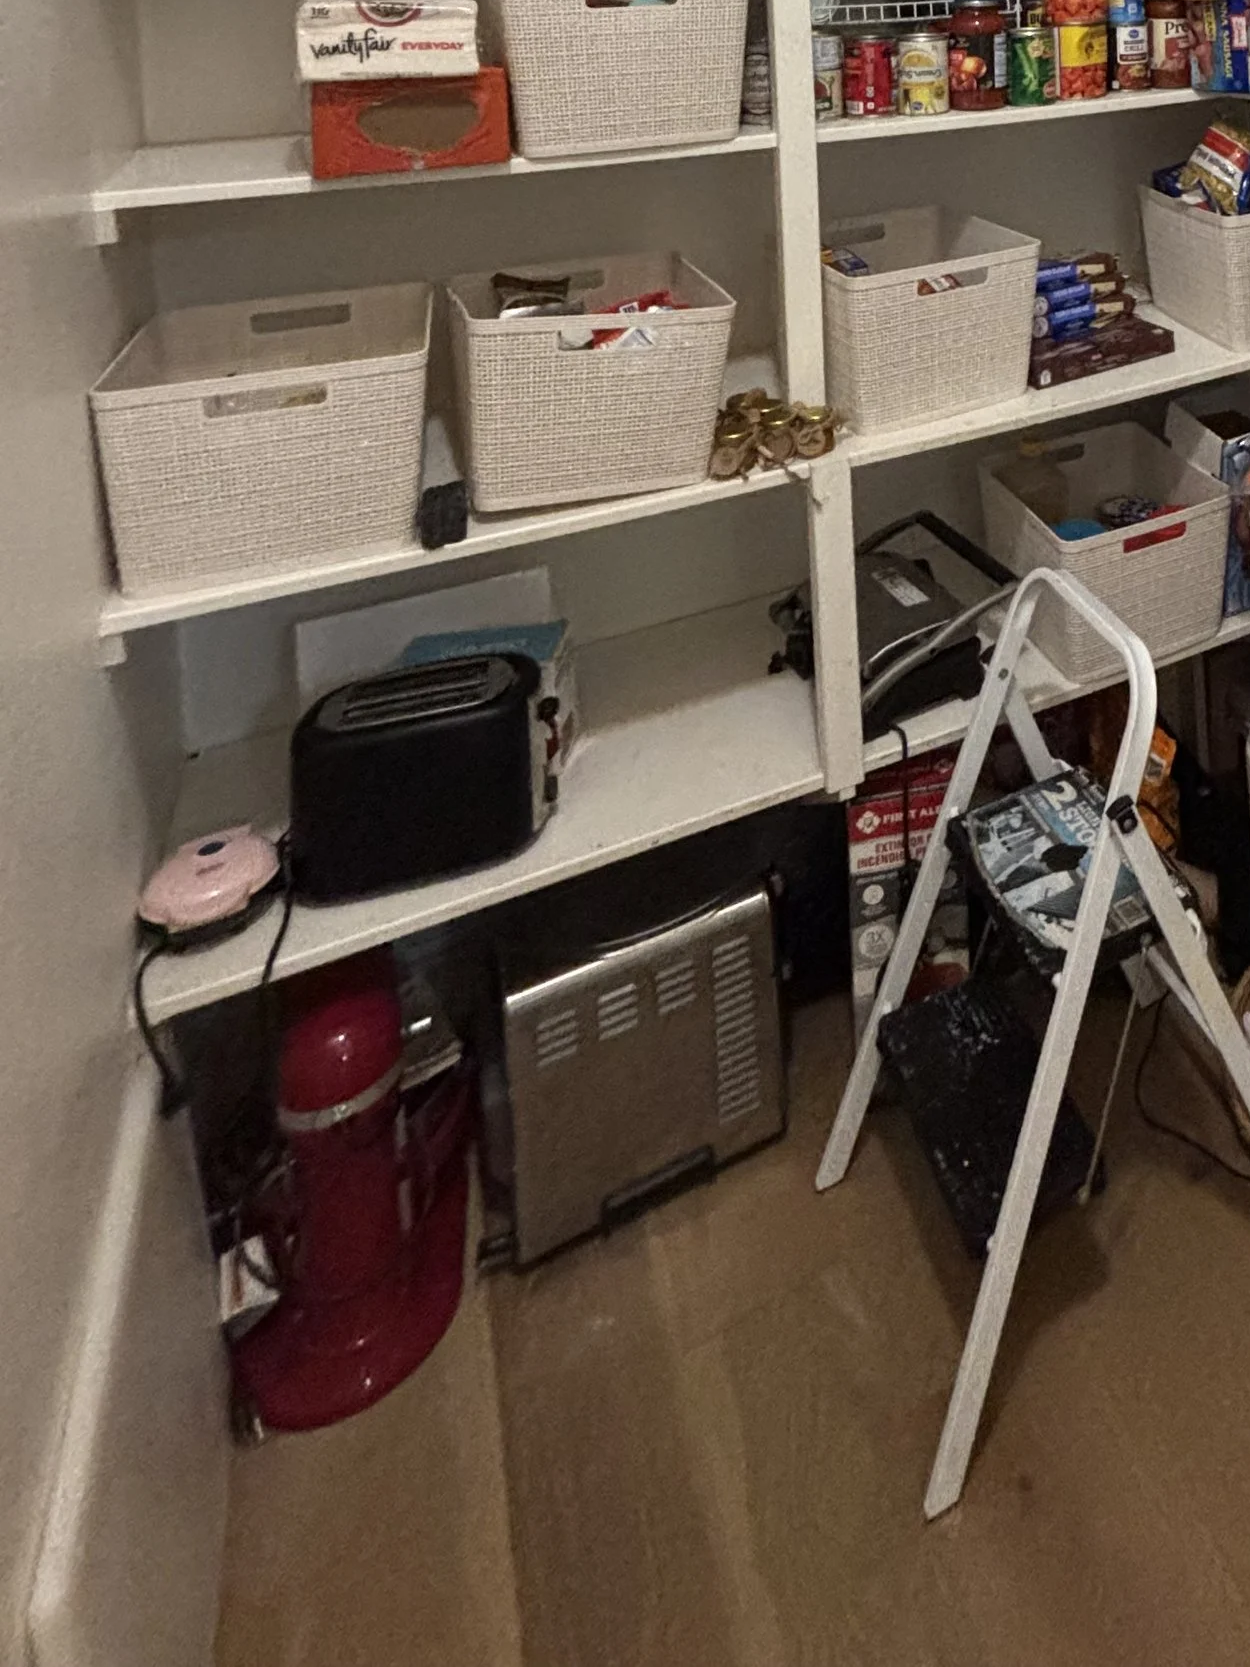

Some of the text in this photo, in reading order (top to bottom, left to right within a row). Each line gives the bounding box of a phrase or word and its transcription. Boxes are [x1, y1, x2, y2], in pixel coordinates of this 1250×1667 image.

[400, 41, 465, 51] EVERYDAY
[1040, 780, 1078, 811] 2
[883, 809, 915, 824] FIRT
